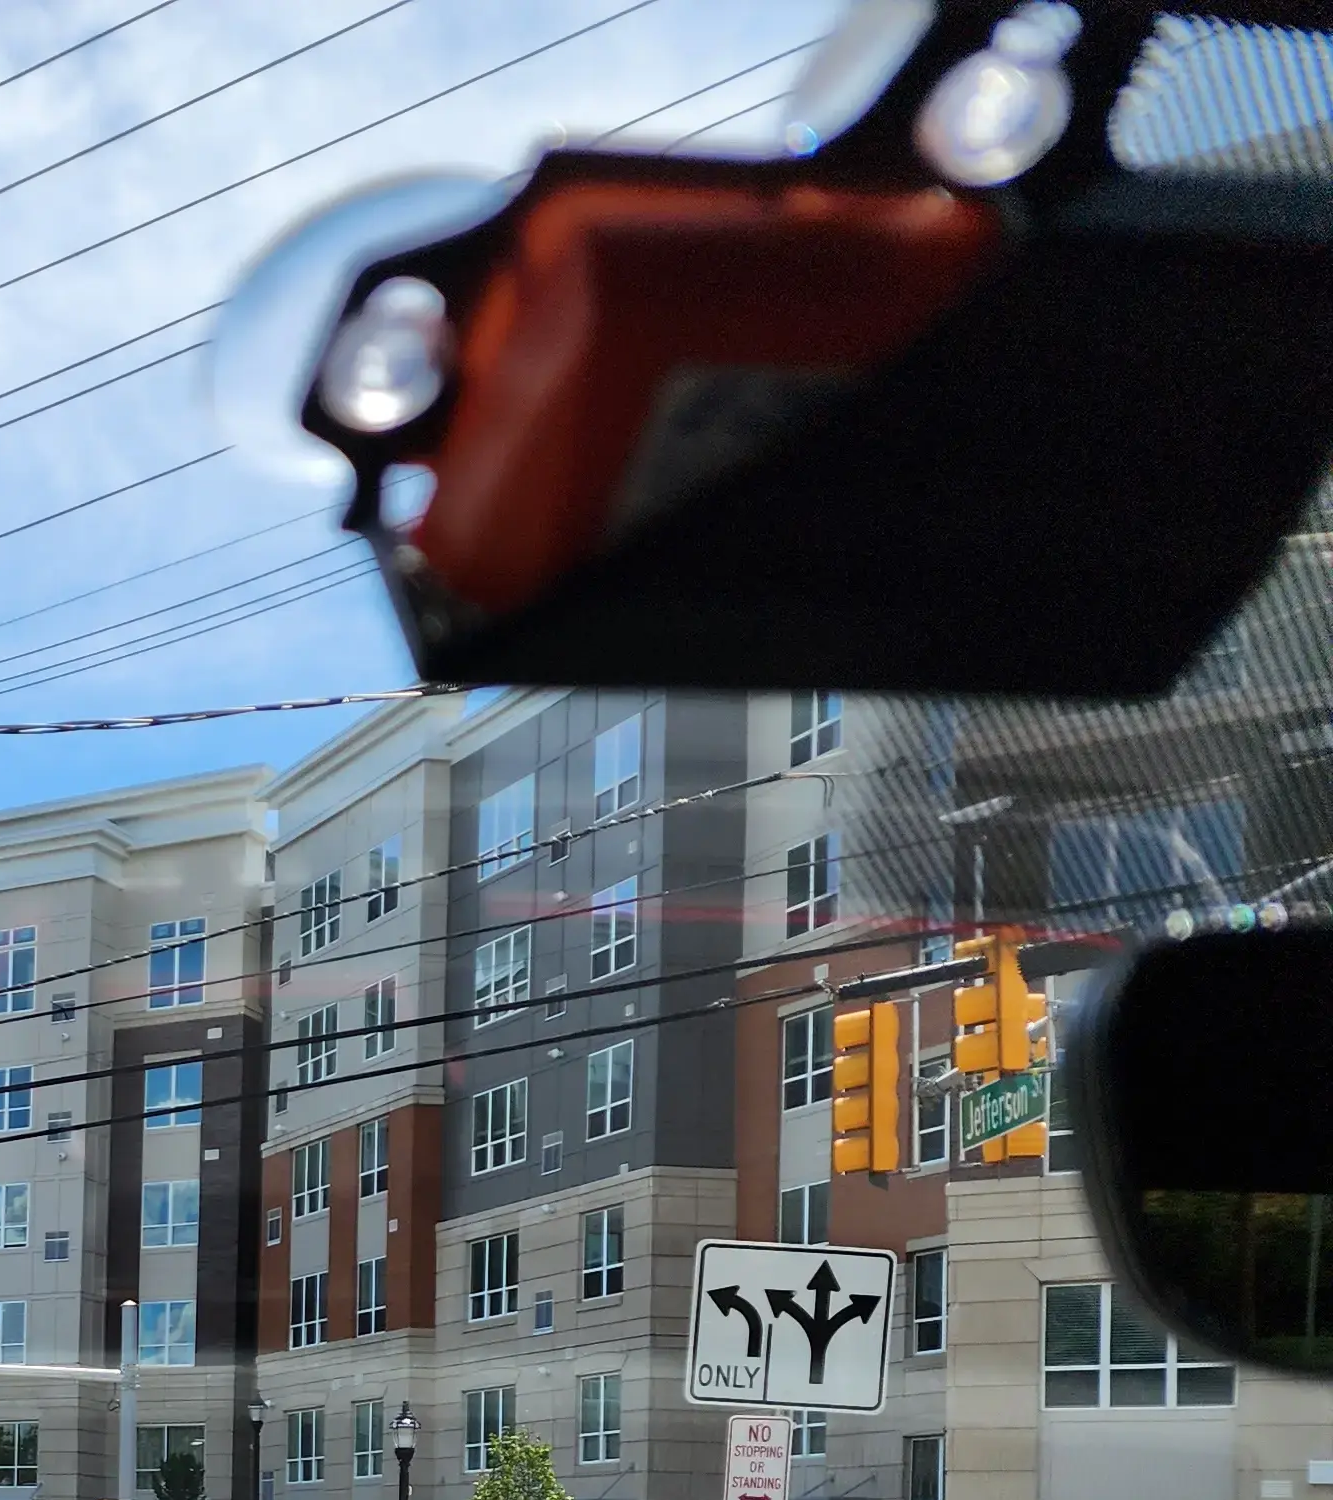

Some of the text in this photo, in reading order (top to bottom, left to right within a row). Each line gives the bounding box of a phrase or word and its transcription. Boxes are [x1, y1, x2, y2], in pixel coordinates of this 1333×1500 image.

[966, 1085, 1028, 1140] Jefferson
[698, 1363, 761, 1389] ONLY
[748, 1425, 771, 1443] NO
[734, 1445, 783, 1458] STOPPING
[750, 1461, 765, 1473] OR
[732, 1476, 781, 1490] STANDING
